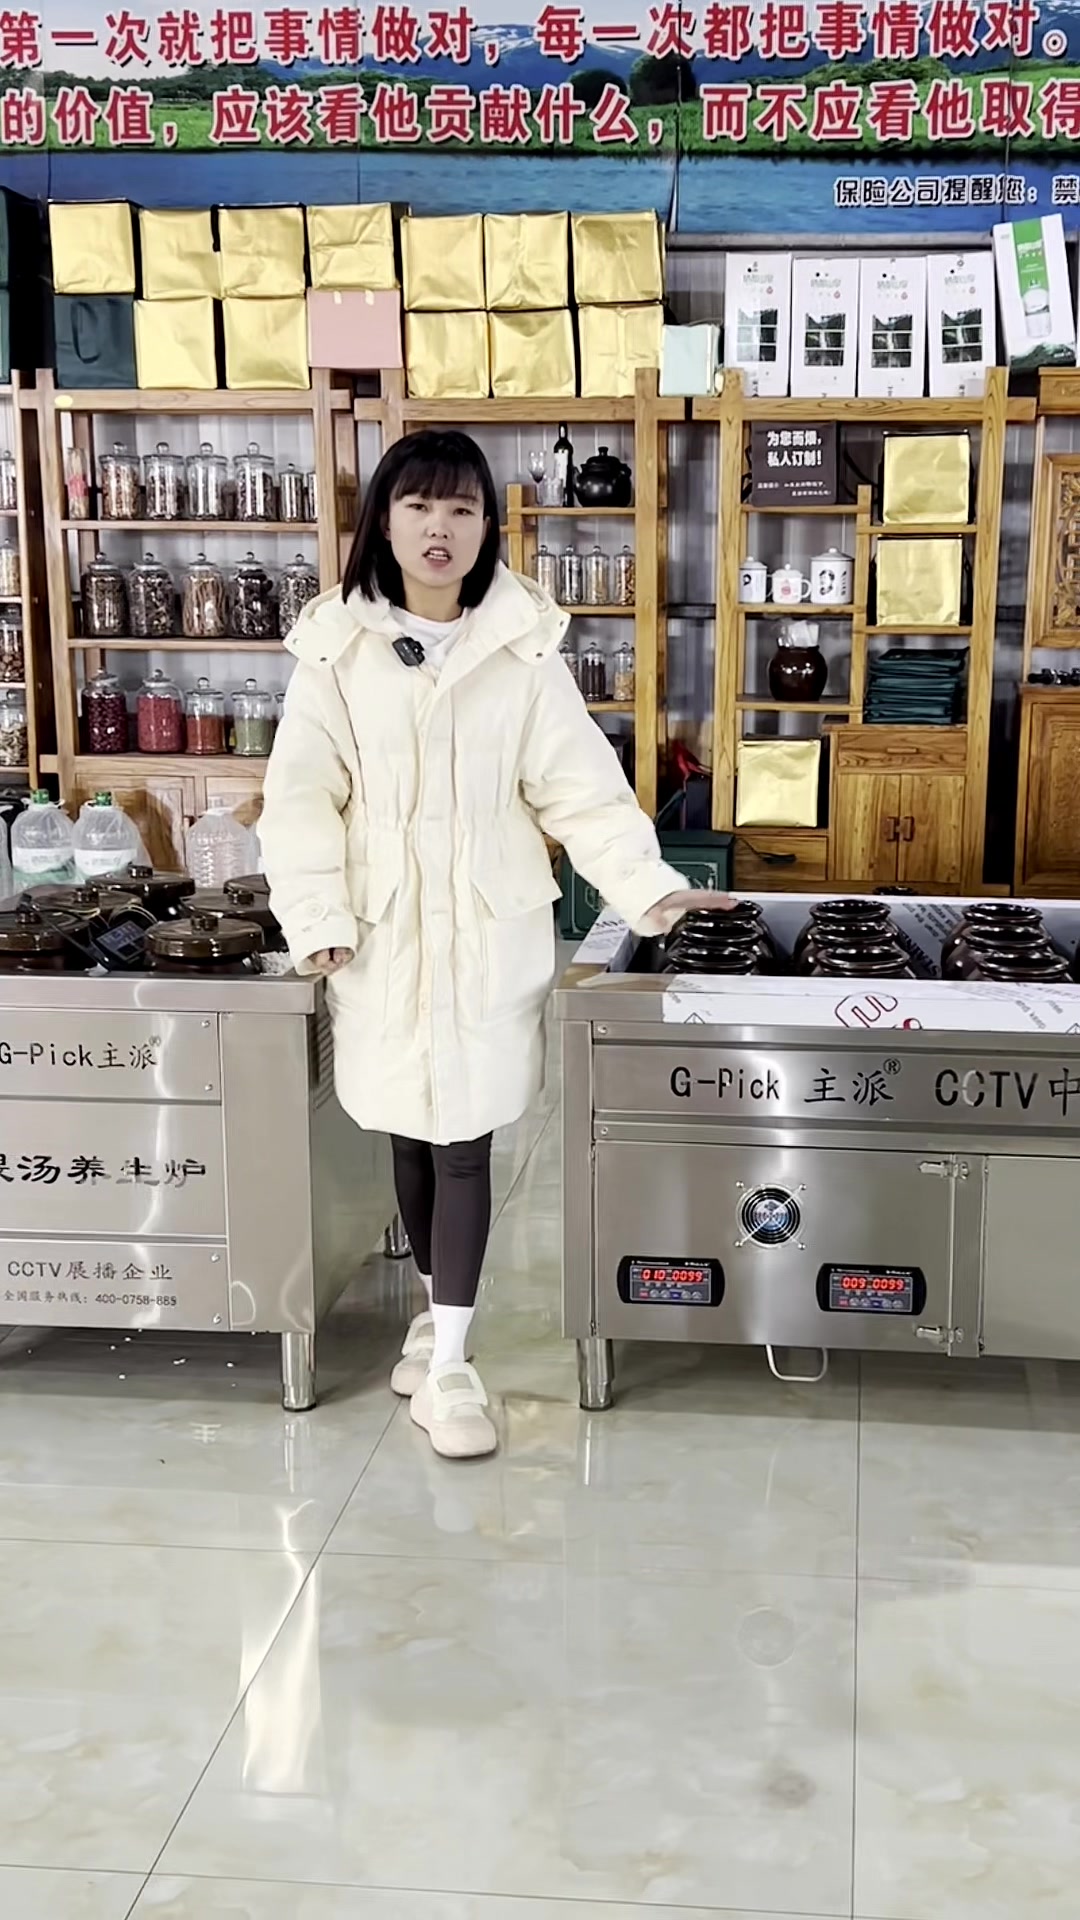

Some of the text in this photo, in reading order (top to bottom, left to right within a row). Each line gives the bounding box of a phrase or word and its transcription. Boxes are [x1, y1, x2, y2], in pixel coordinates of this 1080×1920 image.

[0, 1, 1070, 65] 第一次就把事情做对，每一次都把事情做对。
[2, 80, 1080, 143] 的价值，应该看他贡献什么，而不应看他取得
